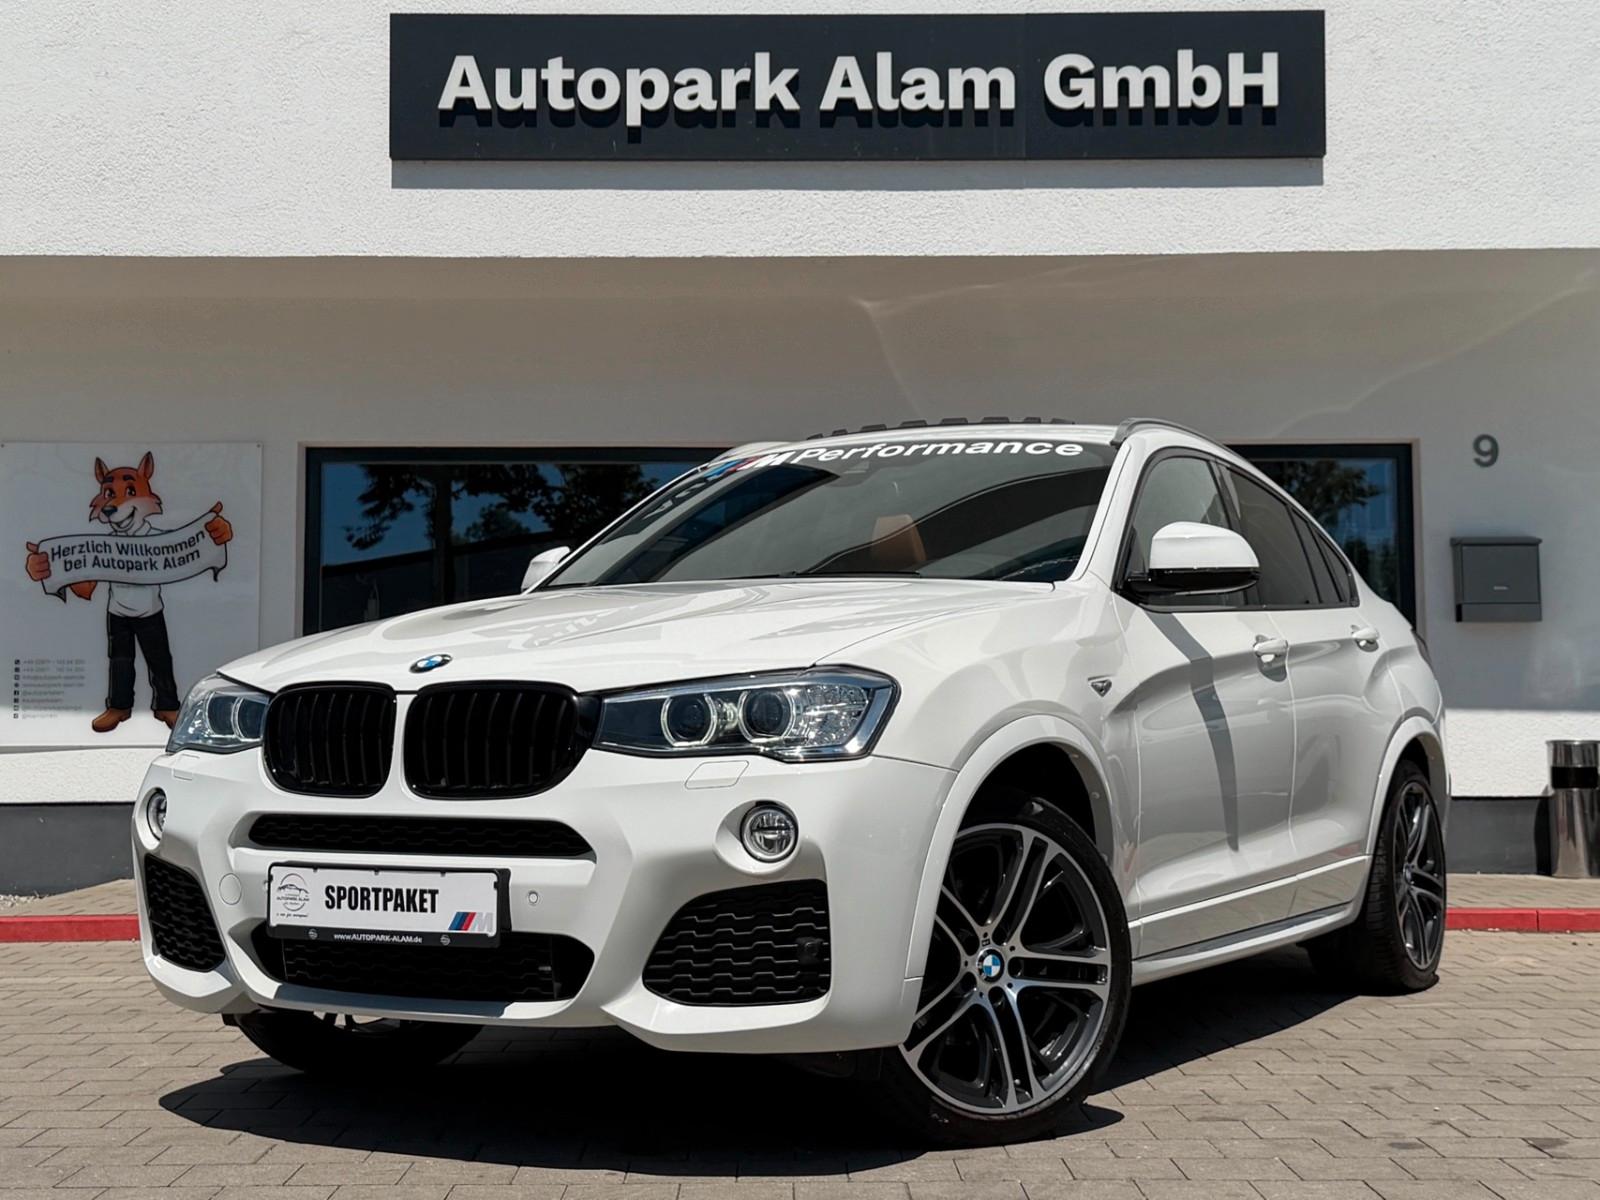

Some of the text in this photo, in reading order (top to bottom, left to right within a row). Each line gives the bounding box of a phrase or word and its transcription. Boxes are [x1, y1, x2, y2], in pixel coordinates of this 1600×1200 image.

[438, 49, 1279, 128] Autopark Alam GmbH
[791, 440, 1084, 464] Performance
[1473, 434, 1499, 468] 9
[51, 530, 206, 562] Herzlich Willkommen
[64, 549, 200, 573] bei Autopark Alam
[325, 885, 439, 913] SPORTPAKET
[333, 933, 423, 944] www.AUTOPARK-ALAM.de
